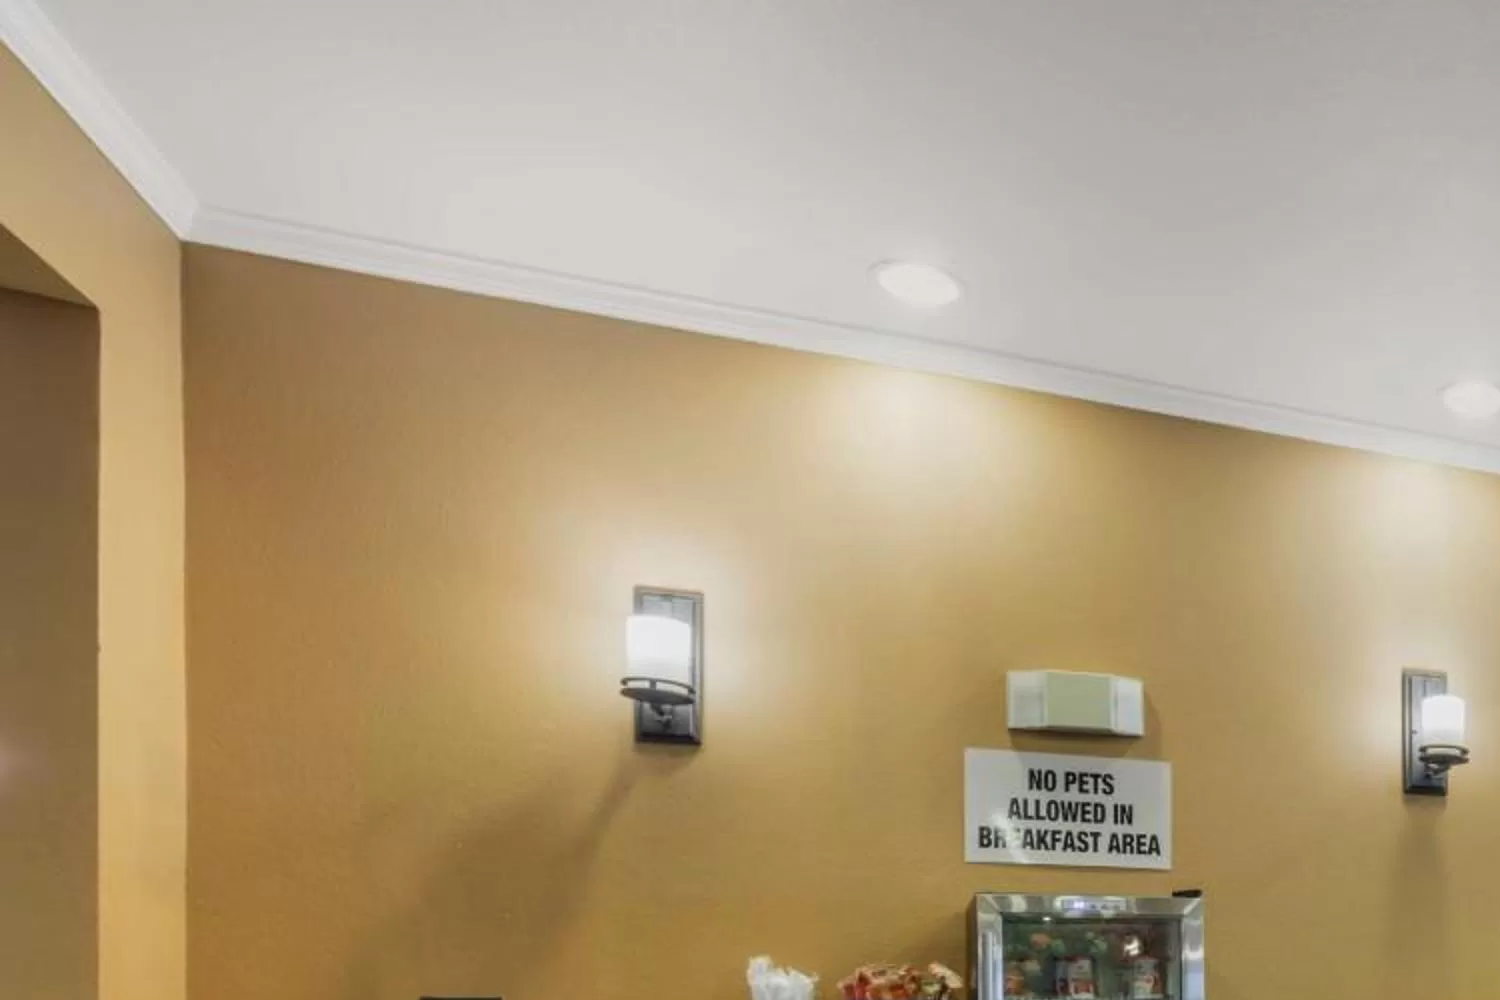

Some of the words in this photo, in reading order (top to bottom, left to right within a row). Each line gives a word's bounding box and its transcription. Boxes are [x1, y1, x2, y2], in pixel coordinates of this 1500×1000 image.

[1028, 768, 1057, 792] NO
[1063, 771, 1115, 796] PETS
[1008, 798, 1106, 824] ALLOWED
[1113, 803, 1133, 825] IN
[978, 826, 1102, 853] BRAKFAST
[1108, 832, 1161, 857] AREA
